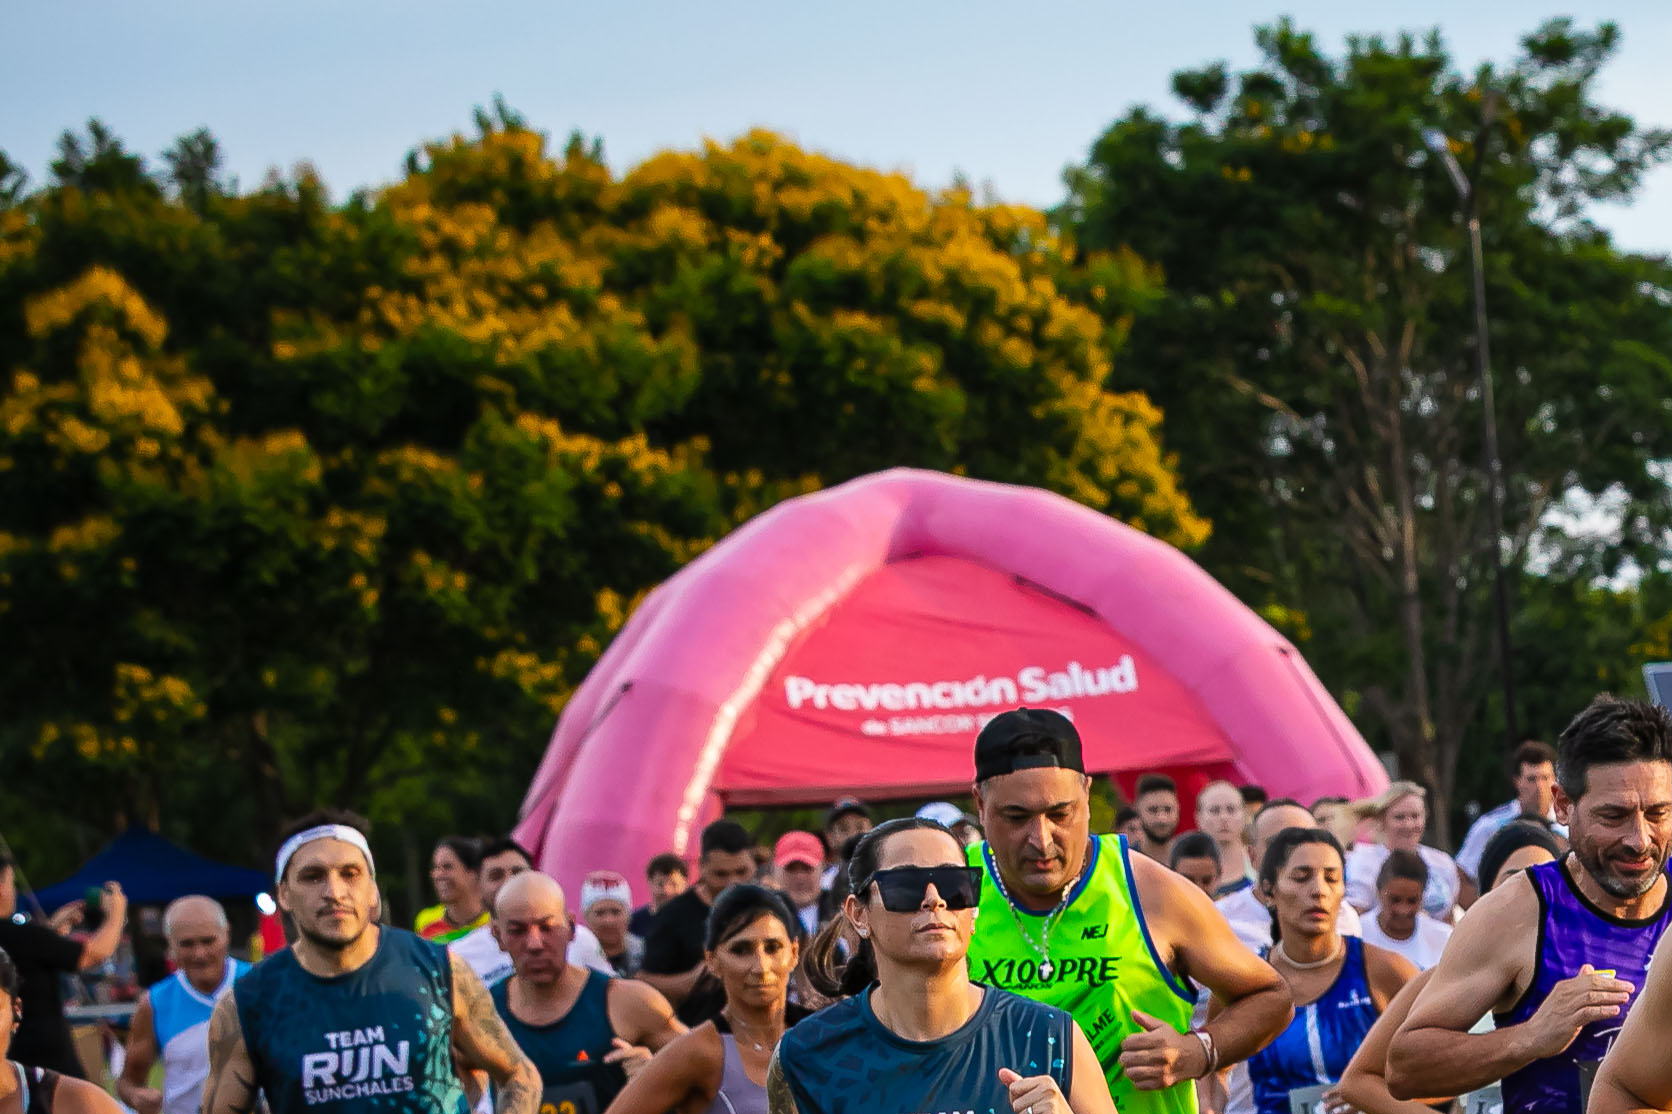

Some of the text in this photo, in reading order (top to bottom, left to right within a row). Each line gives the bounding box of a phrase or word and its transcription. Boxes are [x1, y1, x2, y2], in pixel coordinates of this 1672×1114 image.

[784, 654, 1138, 710] Prevención Salud
[981, 956, 1122, 988] X100PRE
[324, 1025, 385, 1049] TEAM
[302, 1040, 410, 1088] RUN
[304, 1075, 415, 1105] SUNCHALES
